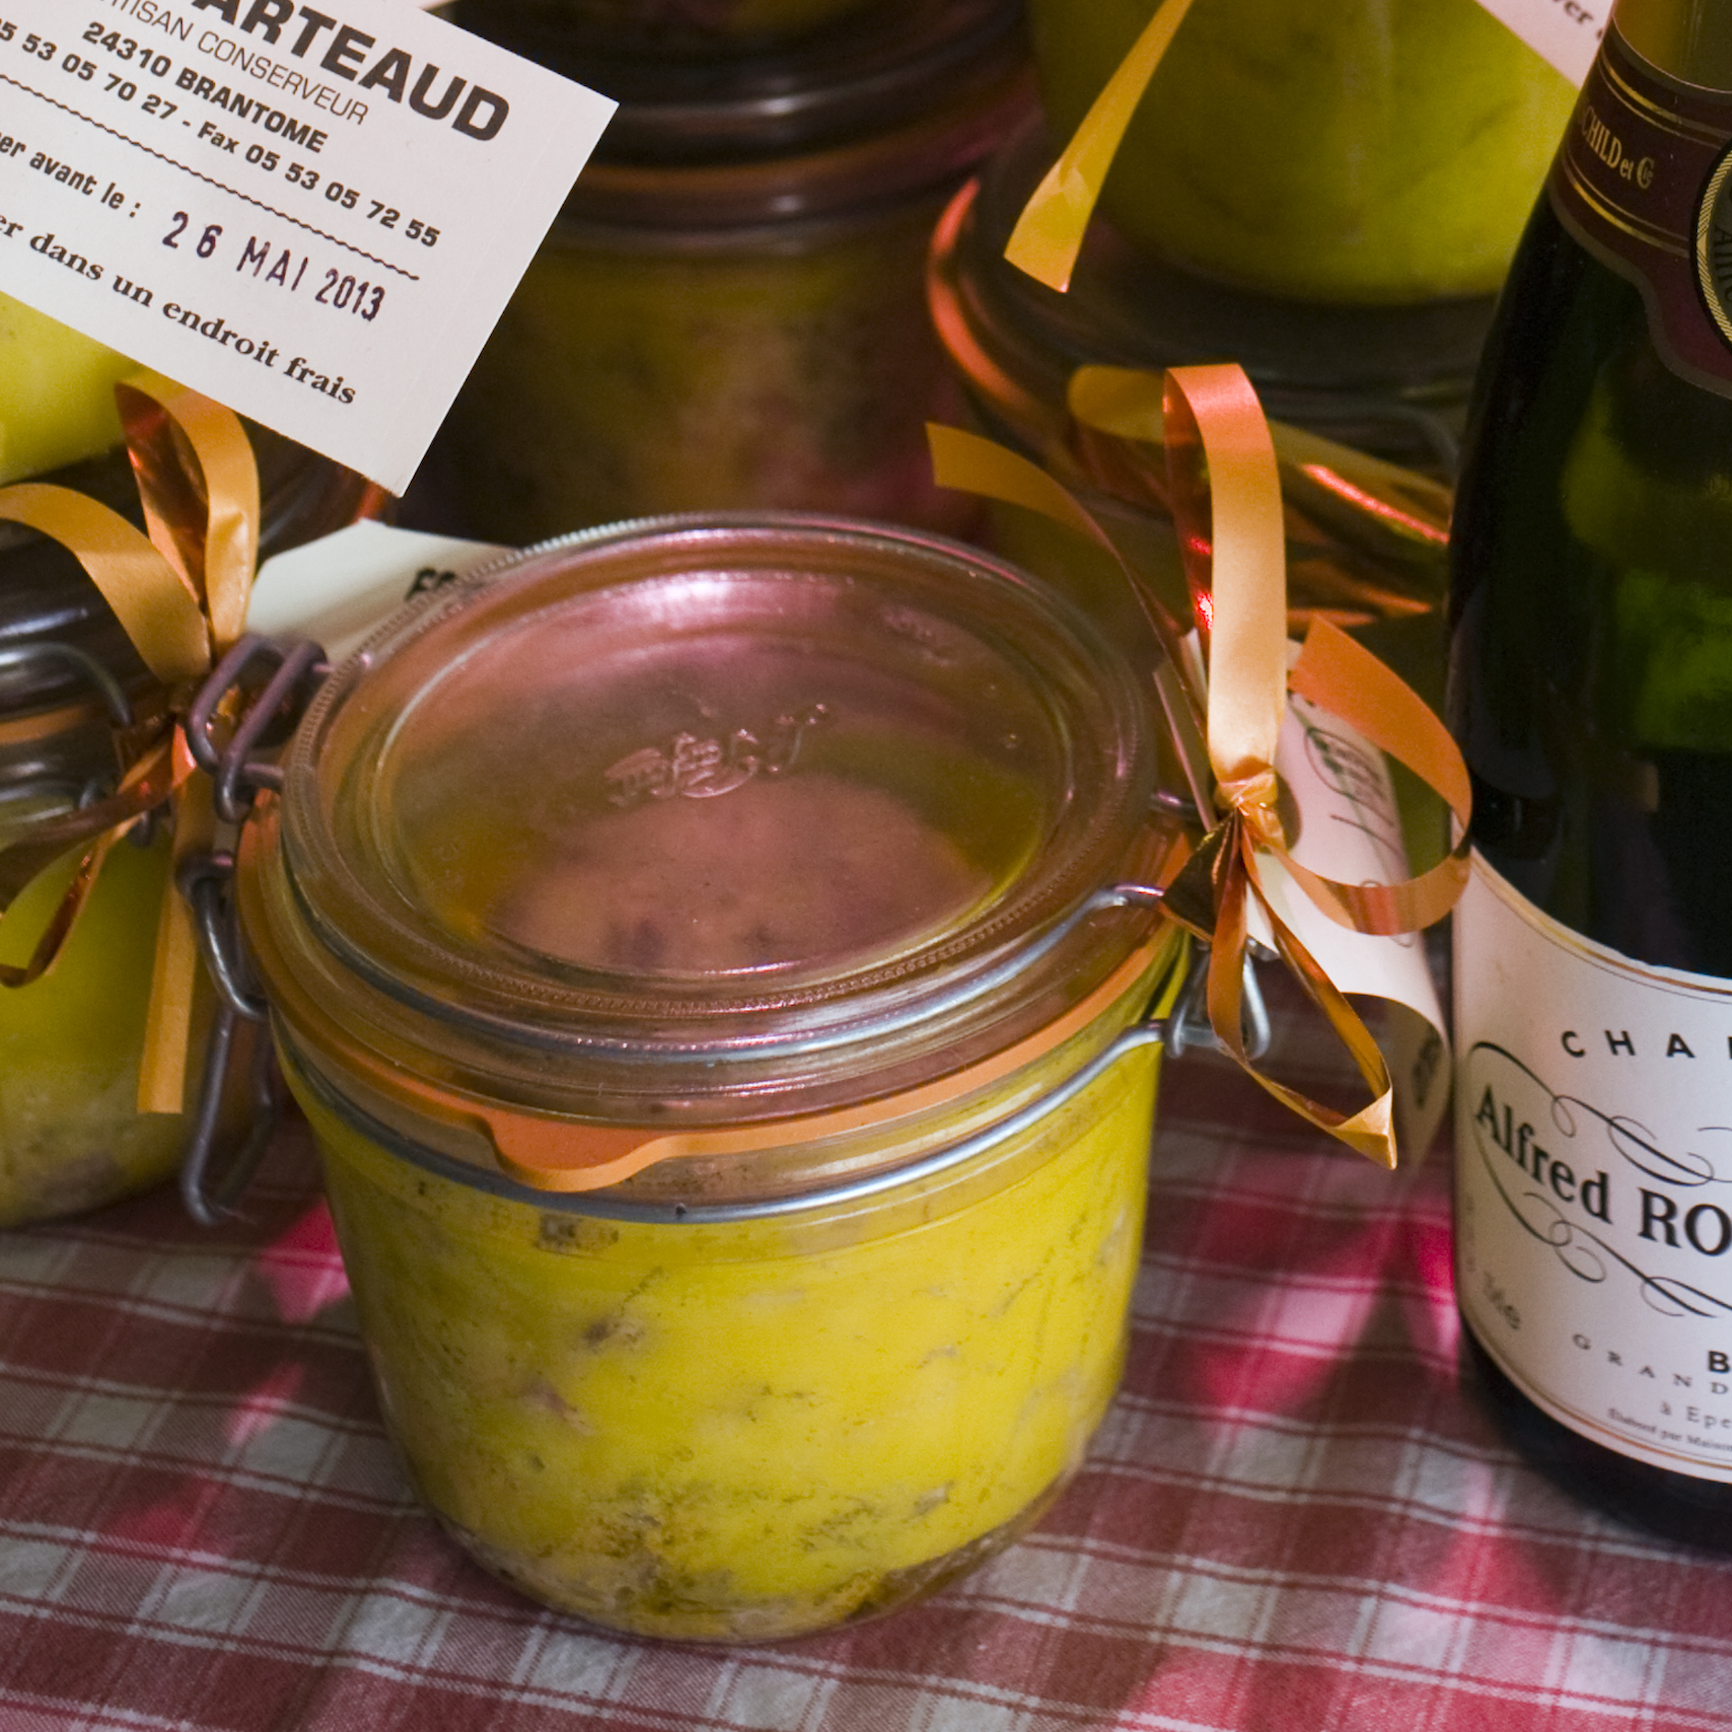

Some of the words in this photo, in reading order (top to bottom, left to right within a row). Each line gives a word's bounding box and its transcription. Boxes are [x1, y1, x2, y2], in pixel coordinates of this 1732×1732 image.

[22, 33, 55, 61] 53
[61, 50, 98, 81] 05
[104, 72, 137, 101] 70
[141, 94, 178, 120] 27
[197, 119, 240, 157] Fax
[245, 142, 281, 173] 05
[284, 161, 320, 191] 53
[324, 180, 363, 212] 05
[366, 199, 402, 231] 72
[404, 218, 442, 249] 55
[82, 21, 171, 77] 24310
[175, 67, 328, 154] BRANTOME
[198, 31, 369, 126] CONSERVEUR
[30, 151, 97, 196] avant
[101, 182, 125, 209] le
[236, 241, 308, 292] MAI
[315, 269, 387, 323] 2013
[29, 232, 104, 281] dans
[112, 274, 153, 308] un
[162, 298, 280, 369] endroit
[283, 352, 357, 406] frais
[1474, 1082, 1612, 1225] Alfred
